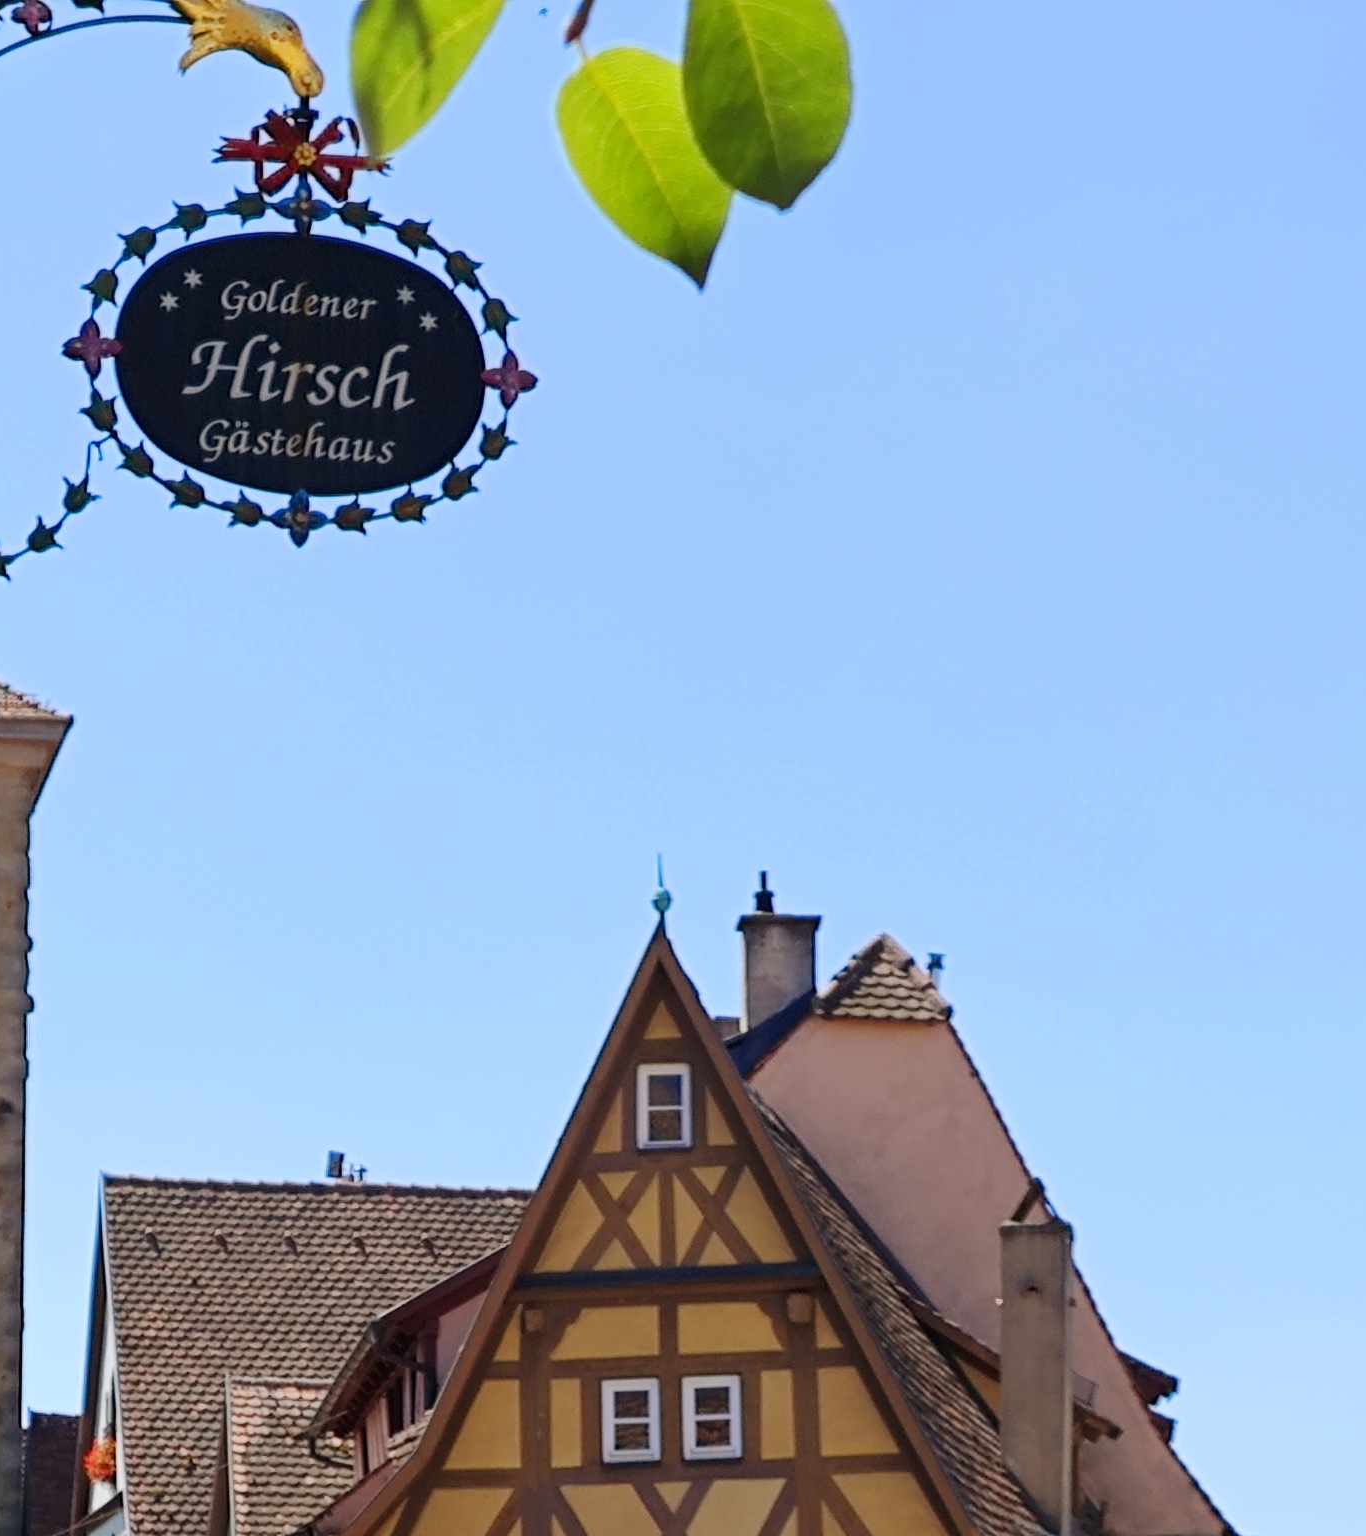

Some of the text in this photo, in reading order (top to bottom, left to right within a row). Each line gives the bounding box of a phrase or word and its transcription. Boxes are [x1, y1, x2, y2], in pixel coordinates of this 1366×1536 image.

[221, 279, 376, 320] Goldener
[182, 334, 416, 411] Hirsch
[198, 418, 396, 465] Gästehaus
